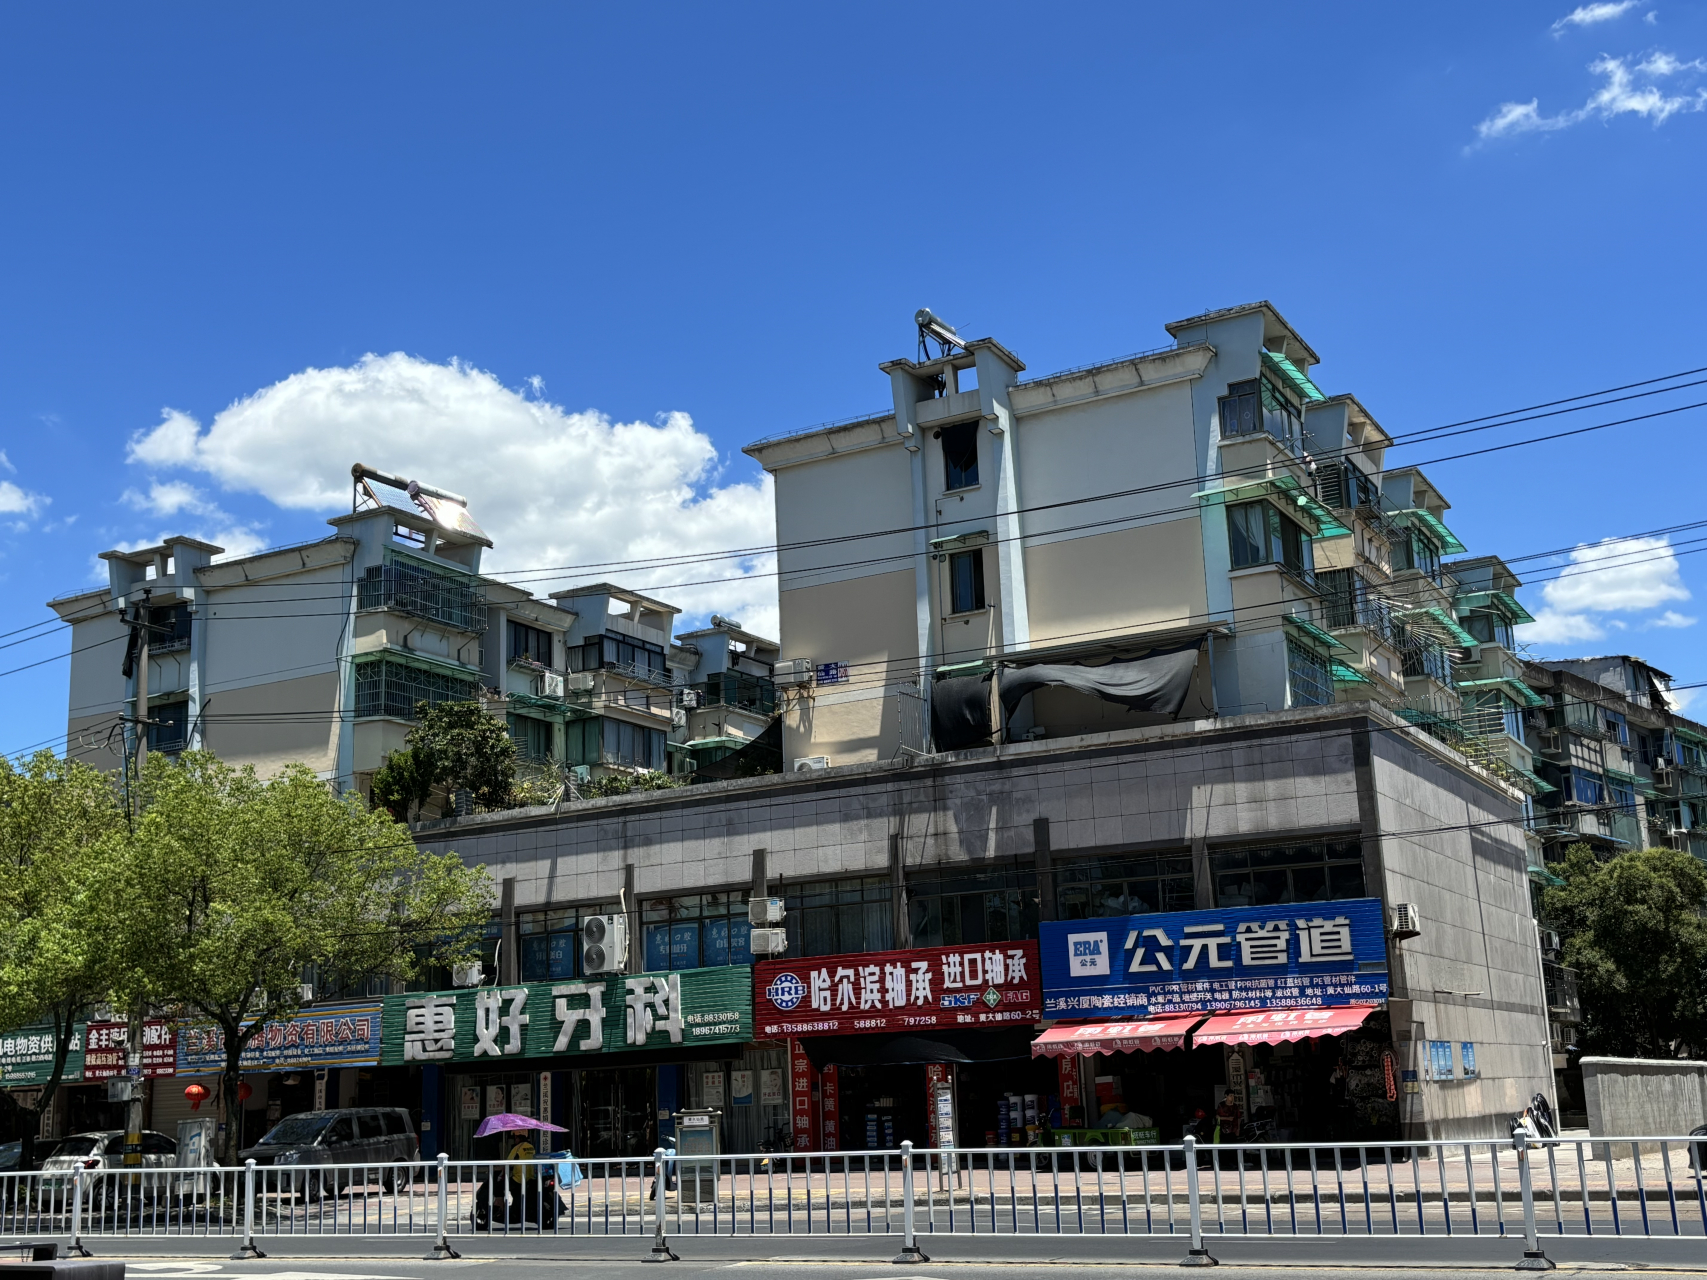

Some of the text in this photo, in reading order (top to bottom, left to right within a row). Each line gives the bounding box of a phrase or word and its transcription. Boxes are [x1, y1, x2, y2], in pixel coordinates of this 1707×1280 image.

[1073, 940, 1102, 957] ERA
[1124, 916, 1354, 973] 公元管道
[941, 949, 1028, 989] 进口轴承
[1080, 958, 1098, 967] 公元
[766, 984, 807, 999] HRB
[810, 961, 933, 1012] 哈尔滨轴承
[1149, 986, 1164, 994] PVC
[1165, 985, 1180, 993] PPR
[1180, 982, 1211, 992] 管材管件
[1213, 981, 1236, 990] 电工管
[940, 992, 980, 1008] SKF
[1003, 990, 1031, 1003] FAG
[1045, 993, 1148, 1012] 兰溪兴厦陶瓷经销商
[1150, 993, 1181, 1003] 水暖产品
[1206, 1000, 1260, 1010] 13906796145
[1266, 997, 1322, 1007] 13588636648
[404, 974, 684, 1061] 惠好牙科
[854, 1019, 886, 1029] 588812
[904, 1016, 937, 1026] 797258
[89, 1025, 172, 1049] 金丰液压动配件
[185, 1017, 371, 1052] 兰溪腾物资有限公司
[0, 1032, 81, 1056] 电物资供站
